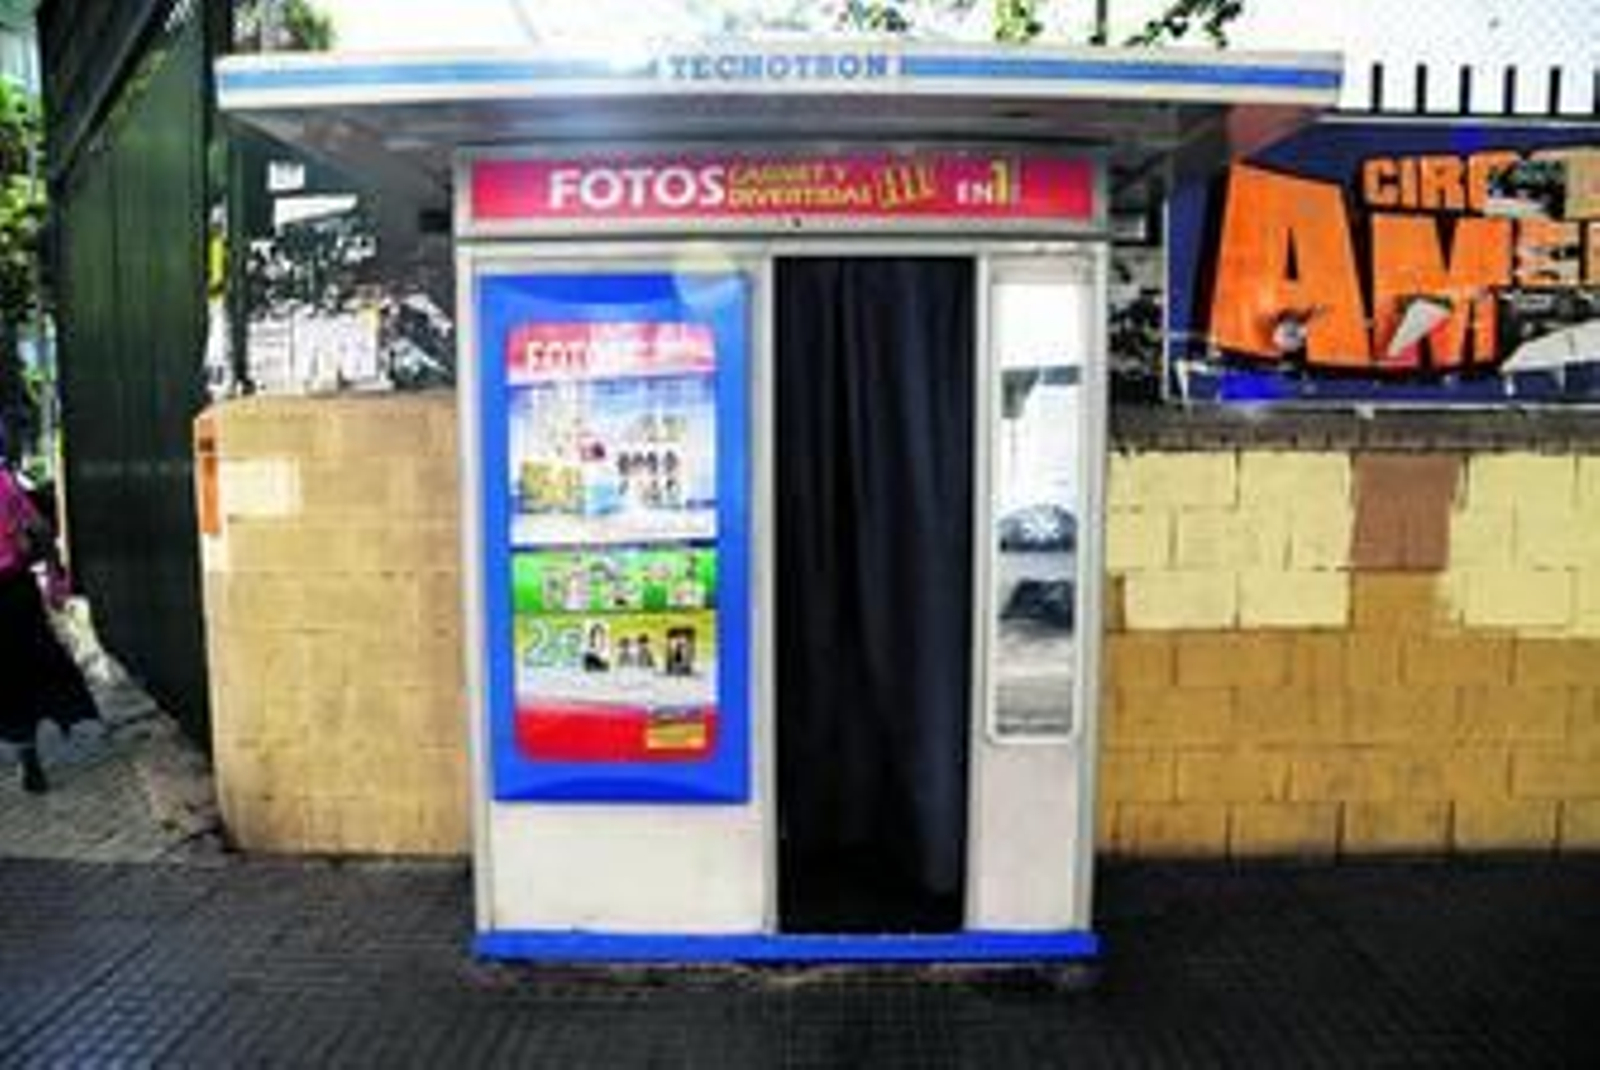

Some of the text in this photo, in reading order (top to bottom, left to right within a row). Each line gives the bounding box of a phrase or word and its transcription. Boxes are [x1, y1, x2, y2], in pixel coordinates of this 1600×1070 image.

[550, 167, 725, 210] FOTOS
[1363, 149, 1550, 209] CIRC
[1209, 158, 1600, 366] AME
